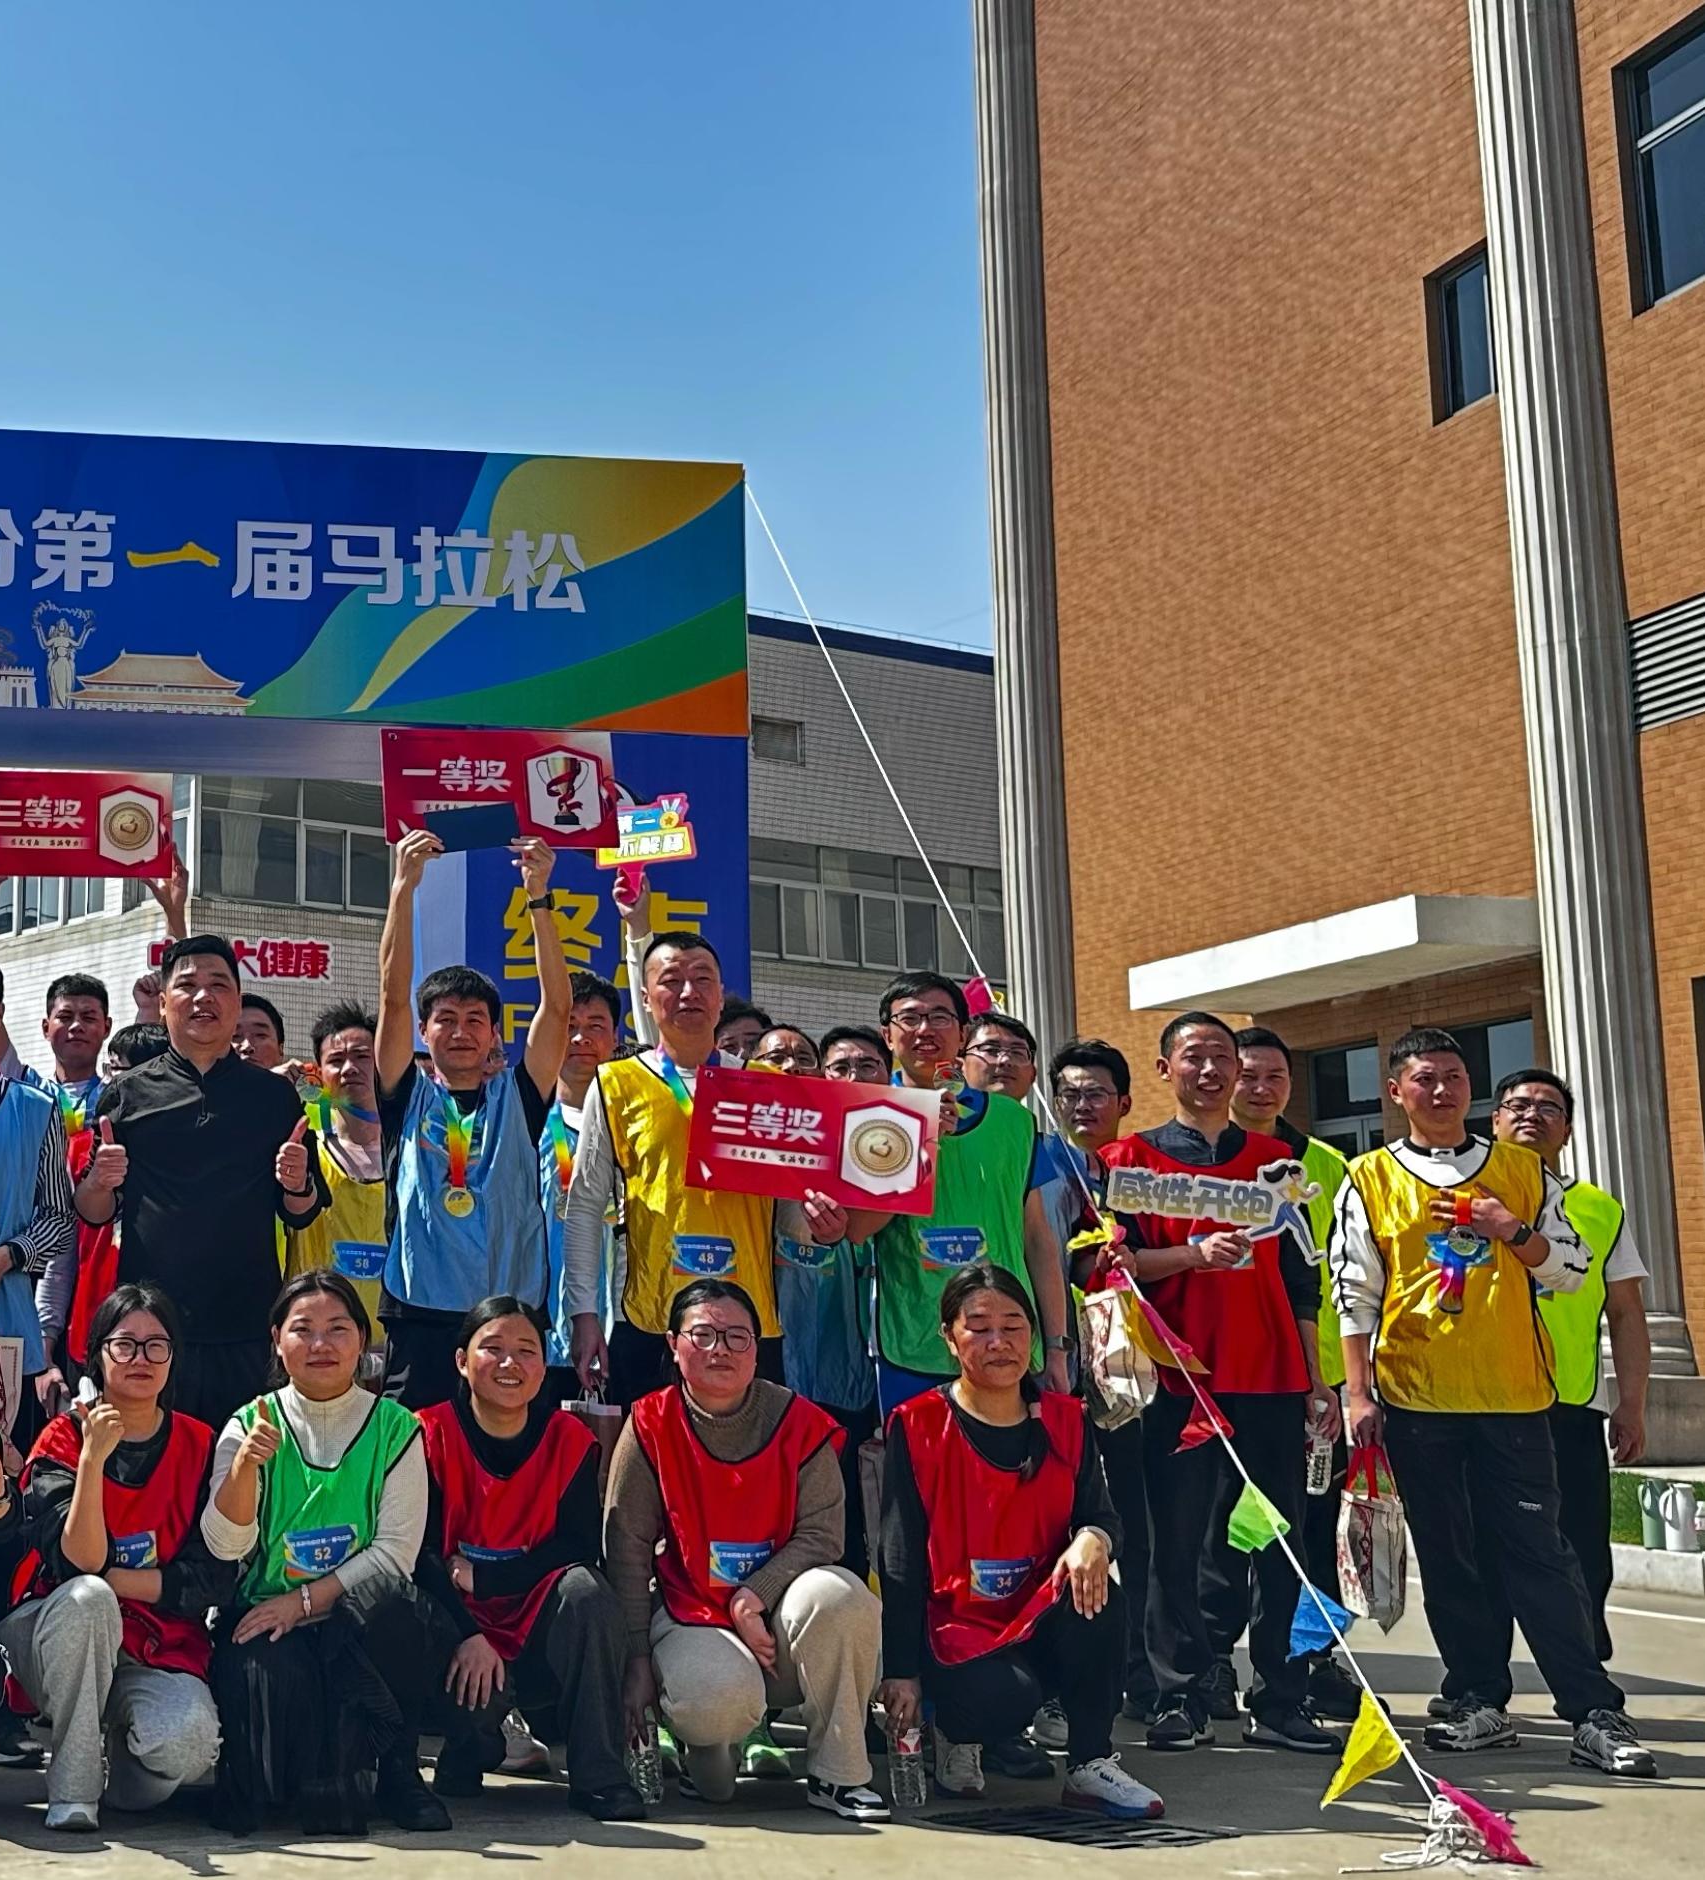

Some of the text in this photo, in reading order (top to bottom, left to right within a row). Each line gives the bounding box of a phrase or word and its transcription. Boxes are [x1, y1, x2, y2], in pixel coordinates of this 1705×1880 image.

[402, 756, 512, 792] 一等奖
[711, 1101, 826, 1145] 三等奖
[1112, 1171, 1273, 1224] 感性开跑
[798, 1246, 814, 1258] 09
[946, 1244, 963, 1256] 54
[698, 1252, 715, 1265] 48
[315, 1546, 332, 1561] 52
[737, 1560, 754, 1574] 37
[997, 1576, 1013, 1589] 34
